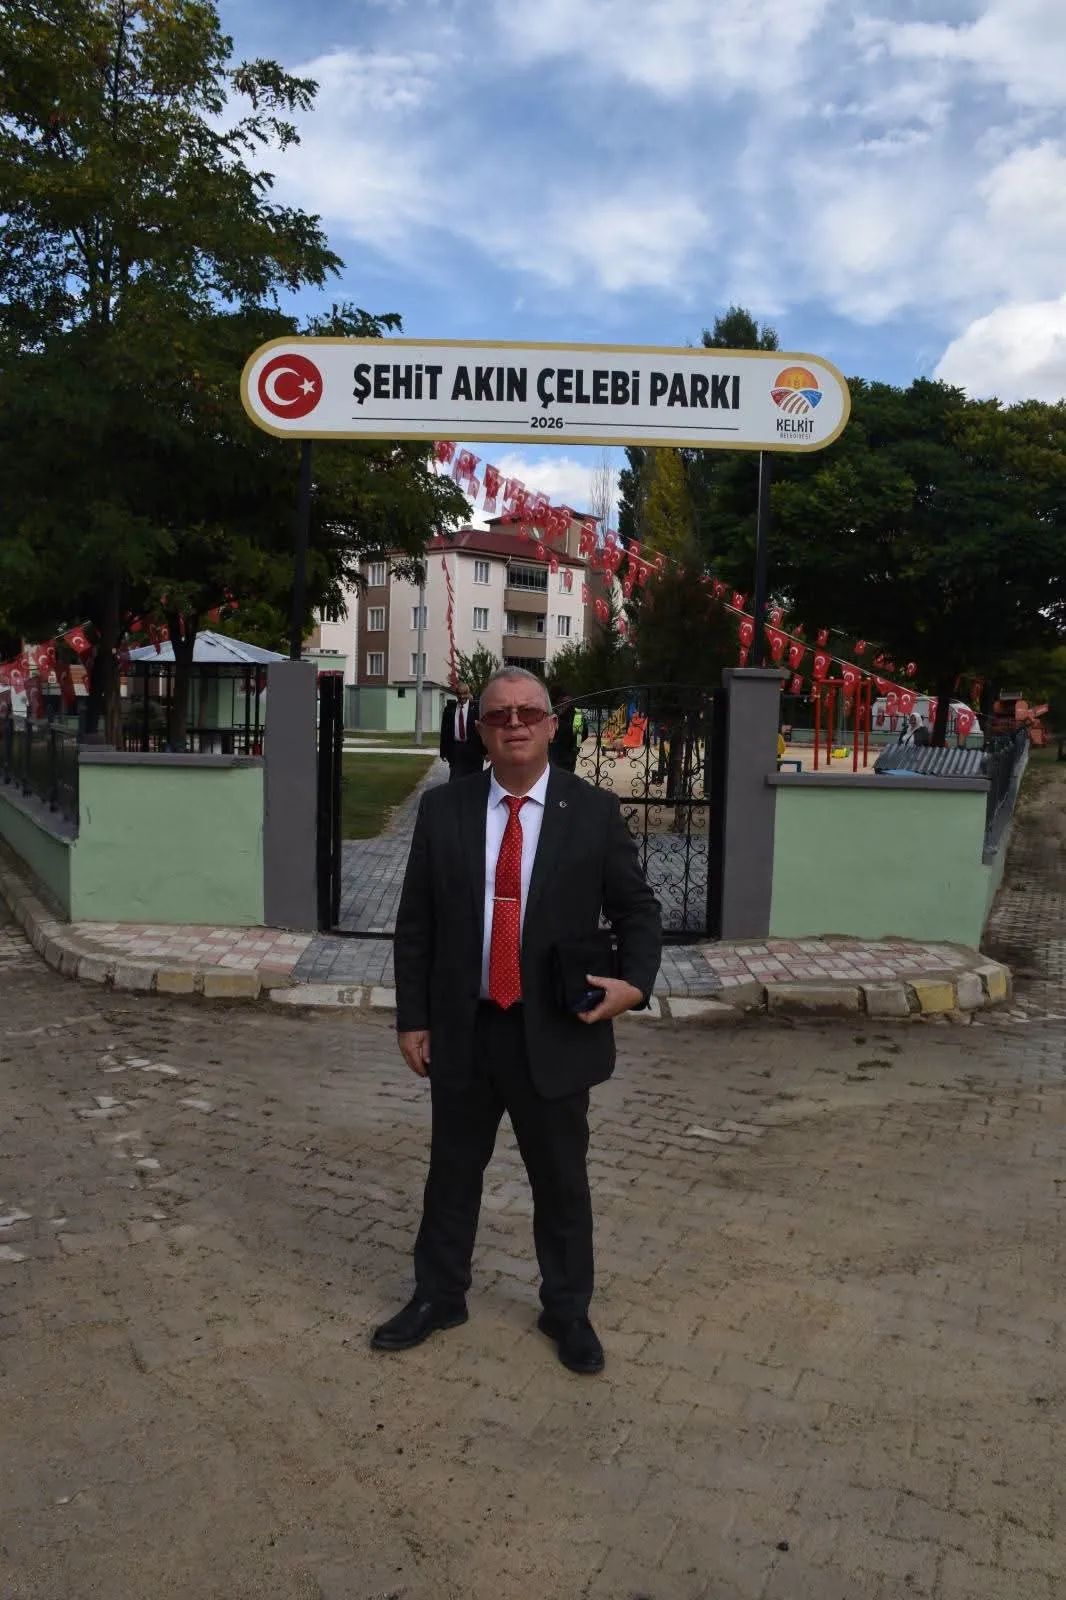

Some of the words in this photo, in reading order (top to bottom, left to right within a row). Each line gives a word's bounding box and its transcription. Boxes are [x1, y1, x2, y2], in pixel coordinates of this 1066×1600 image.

[451, 366, 527, 402] AKIN
[650, 372, 740, 409] PARKI
[531, 417, 563, 428] 2026
[776, 418, 814, 432] KELKİT
